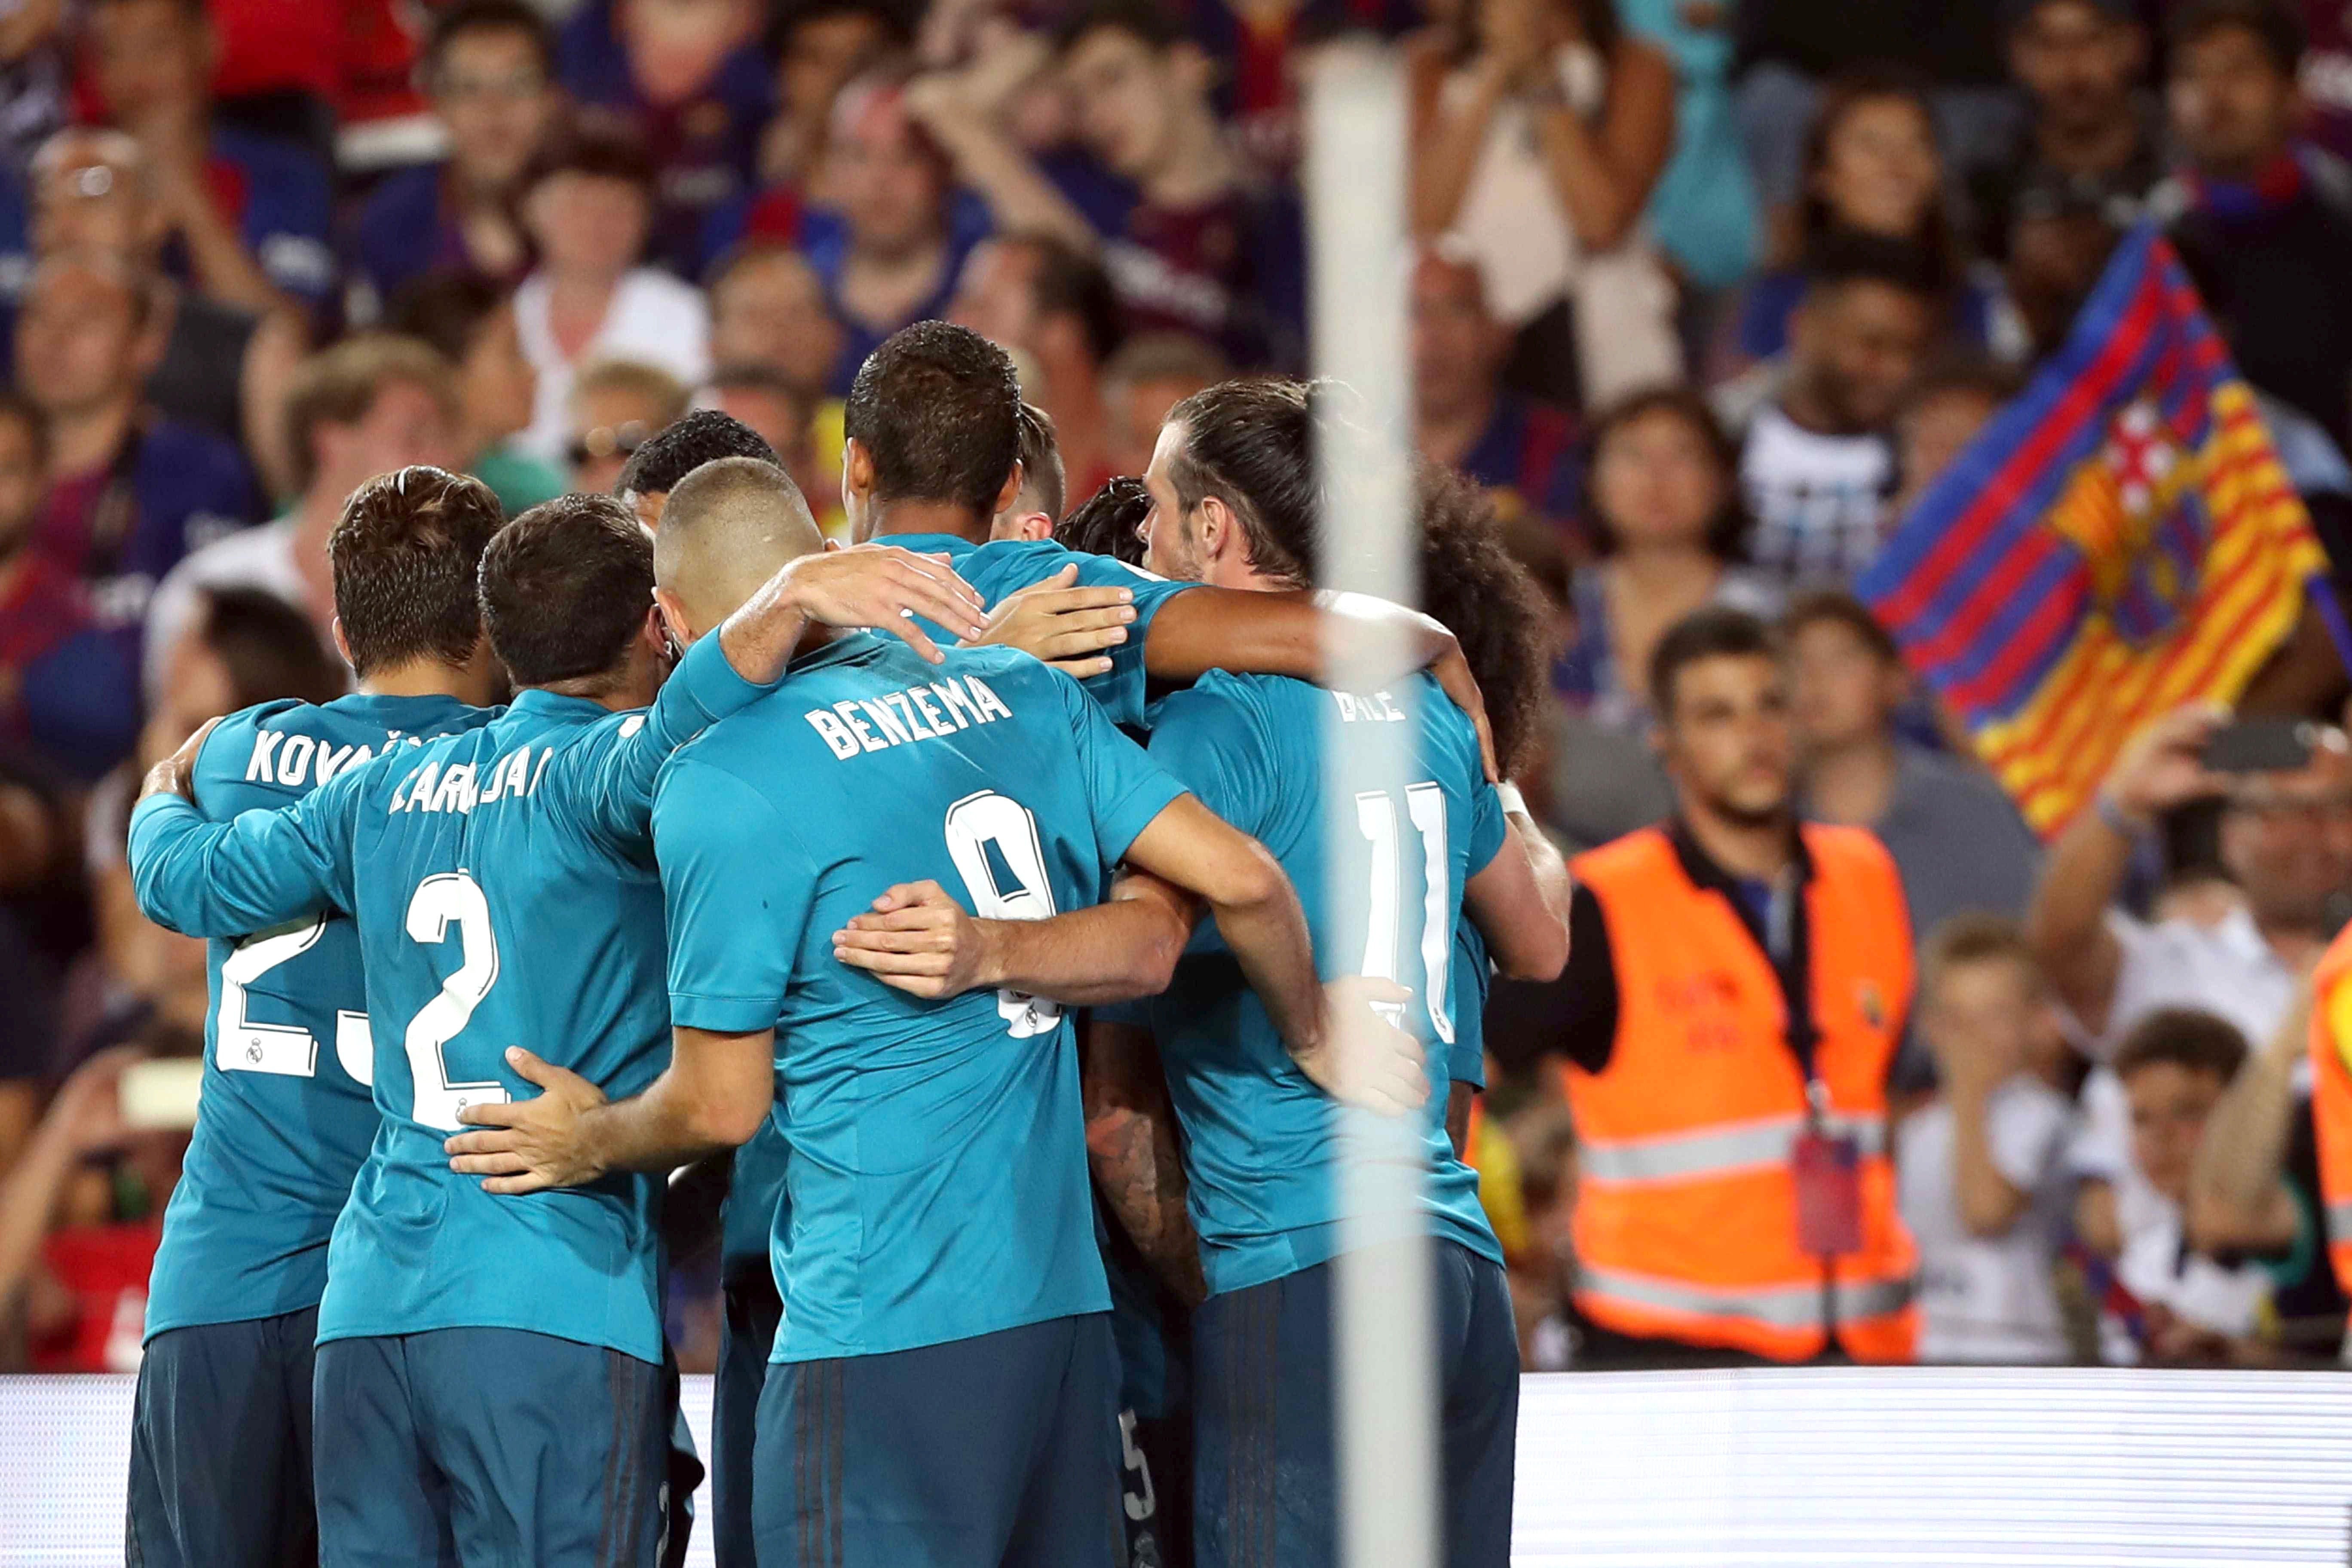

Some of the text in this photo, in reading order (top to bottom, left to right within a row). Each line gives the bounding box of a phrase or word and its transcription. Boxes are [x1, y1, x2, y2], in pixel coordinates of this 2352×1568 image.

[245, 730, 450, 787] KOVA
[805, 674, 1013, 760] BENZEMA
[216, 909, 374, 1087] 2
[405, 867, 511, 1131] 2
[945, 789, 1062, 1038] 9
[1355, 781, 1455, 1044] 11
[1118, 1408, 1155, 1521] 5
